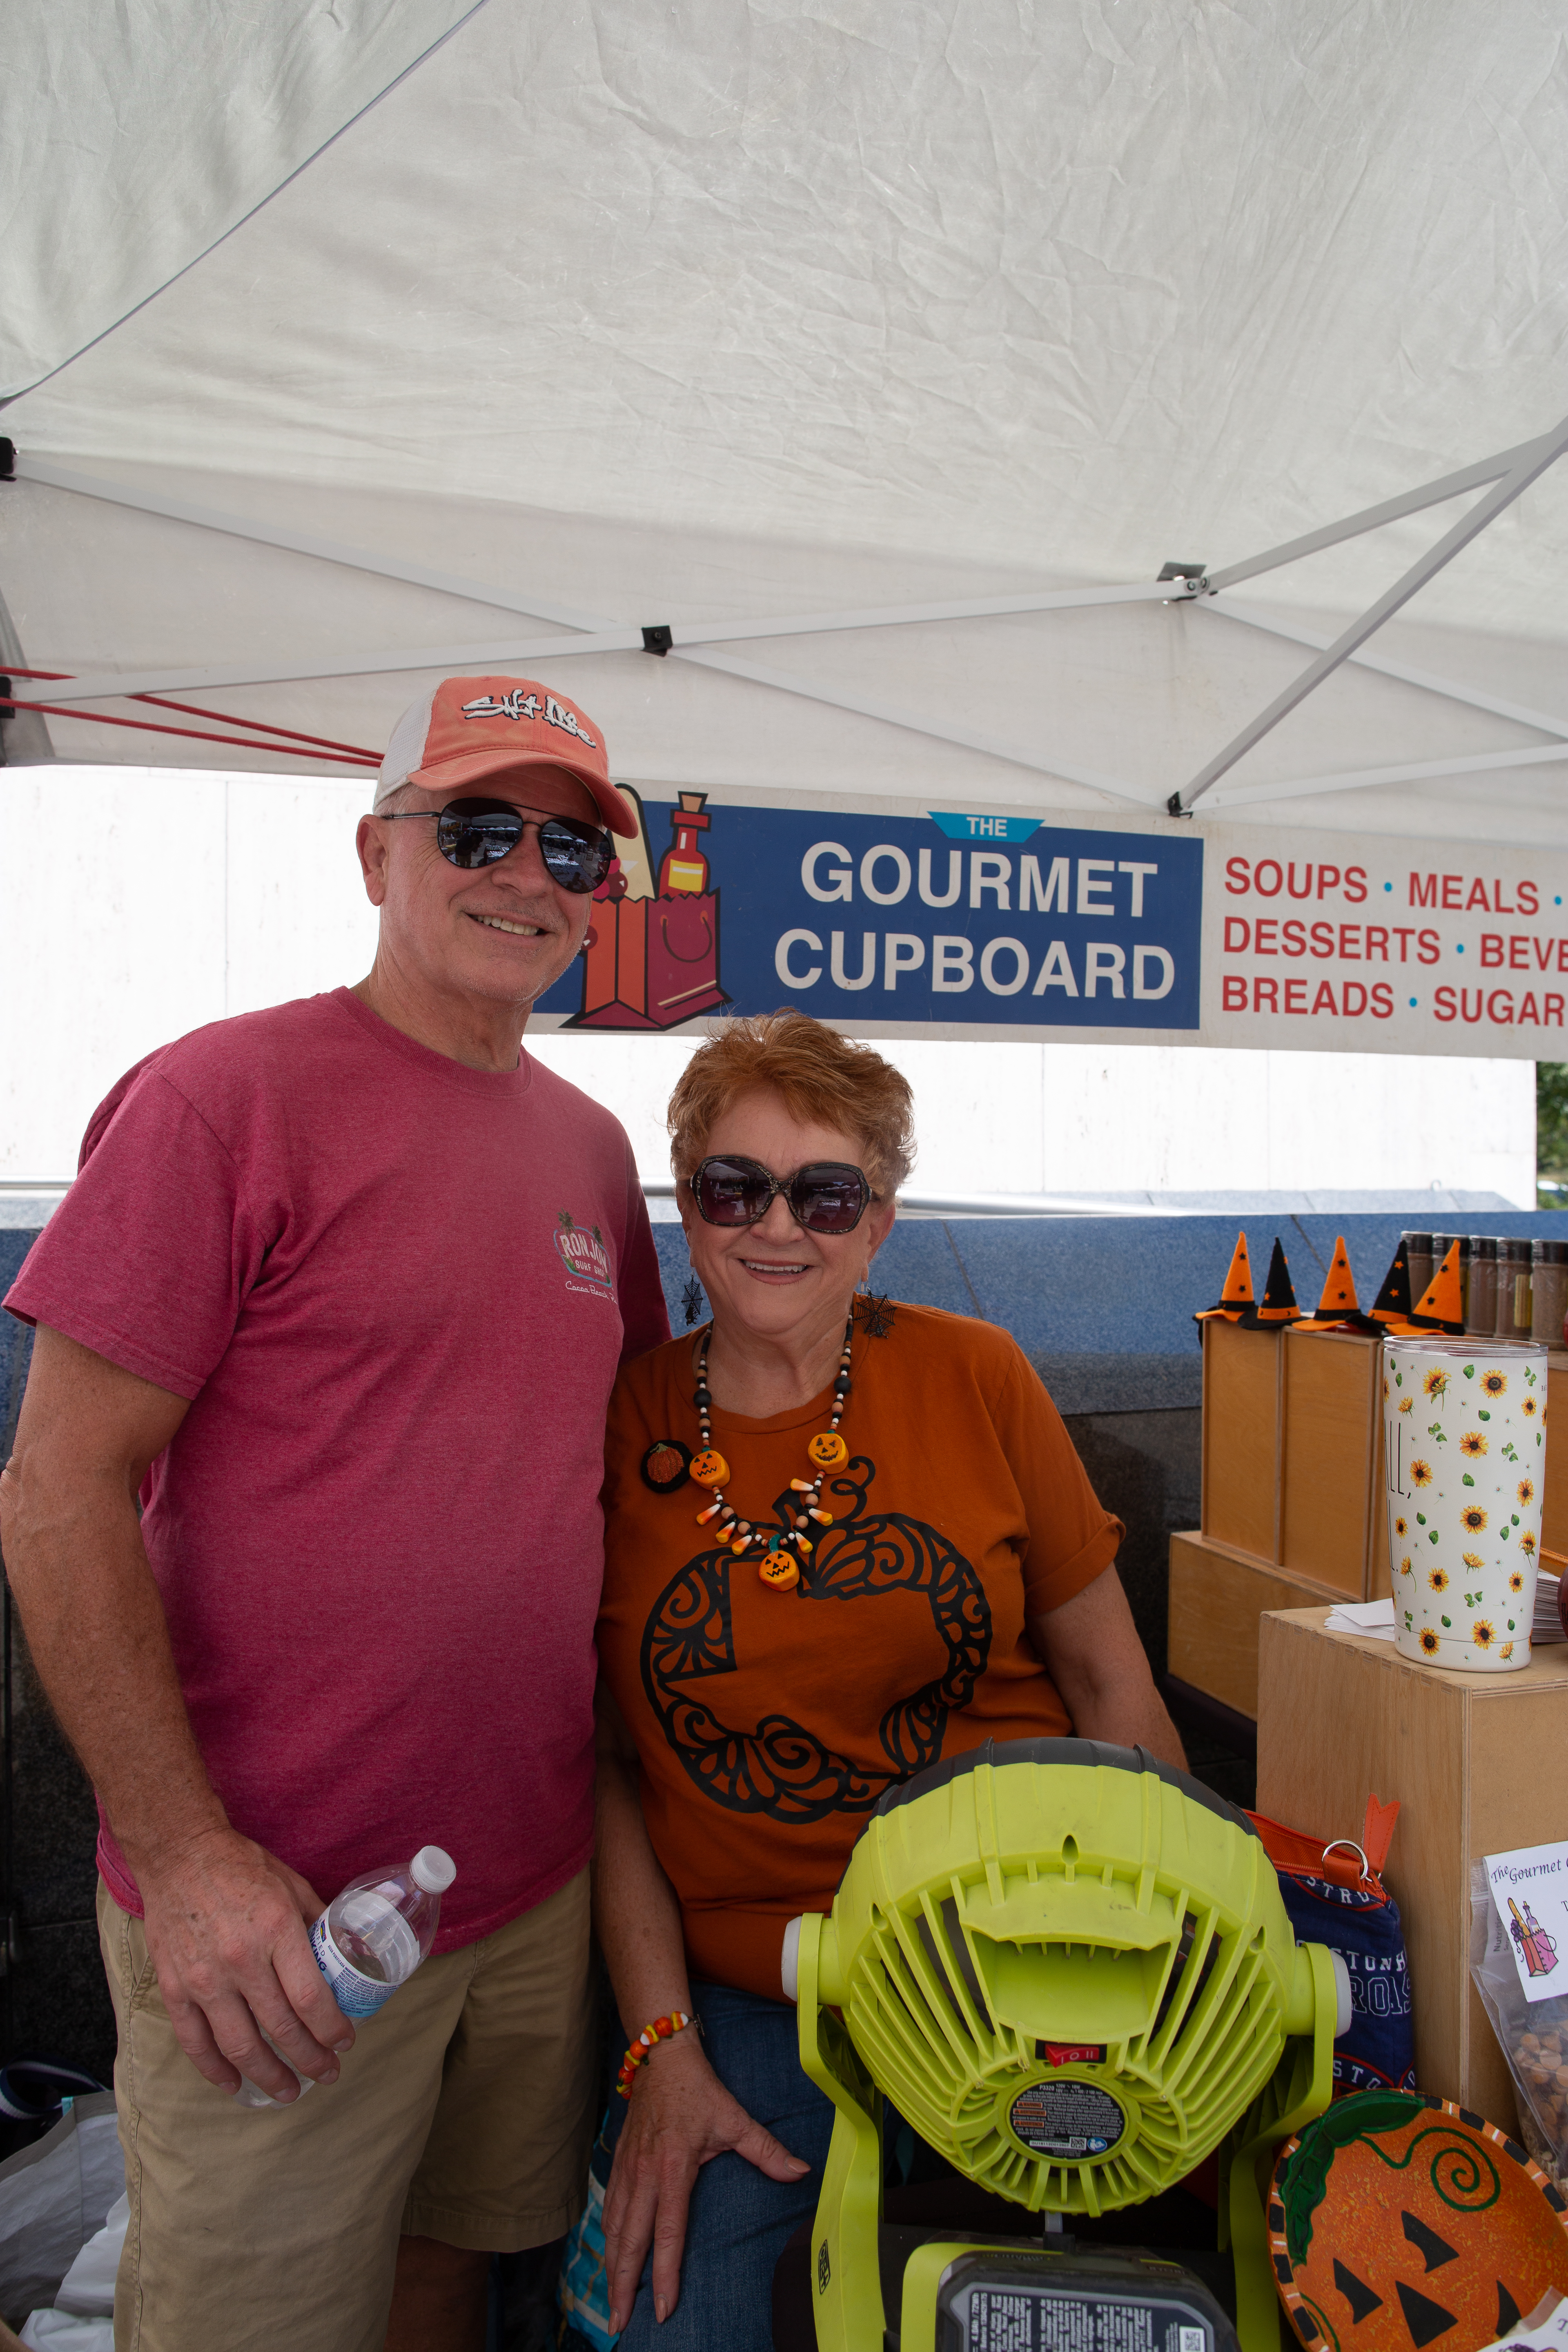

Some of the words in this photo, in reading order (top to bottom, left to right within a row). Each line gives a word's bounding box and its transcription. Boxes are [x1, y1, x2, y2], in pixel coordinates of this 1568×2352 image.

[967, 817, 1007, 837] THE
[801, 841, 1158, 918] GOURMET
[1225, 856, 1368, 903] SOUPS
[1408, 872, 1540, 915] MEALS
[1224, 916, 1441, 965] DESSERTS
[774, 928, 1175, 1000] CUPBOARD
[1223, 975, 1394, 1019] BREADS
[1433, 986, 1565, 1027] SUGAR
[560, 1233, 590, 1258] RON
[590, 1239, 608, 1273] JON
[575, 1260, 591, 1272] SURF
[566, 1281, 590, 1293] Cocoa
[589, 1285, 610, 1300] Beach
[1491, 1865, 1509, 1884] The
[1509, 1858, 1561, 1885] Gourmet
[1493, 1911, 1502, 1952] Nutritio
[332, 1951, 345, 1968] PURIFICADA
[340, 1971, 352, 1982] PROCESSED
[338, 1974, 354, 1988] INGREDIENTES:
[820, 2246, 829, 2289] ONE+
